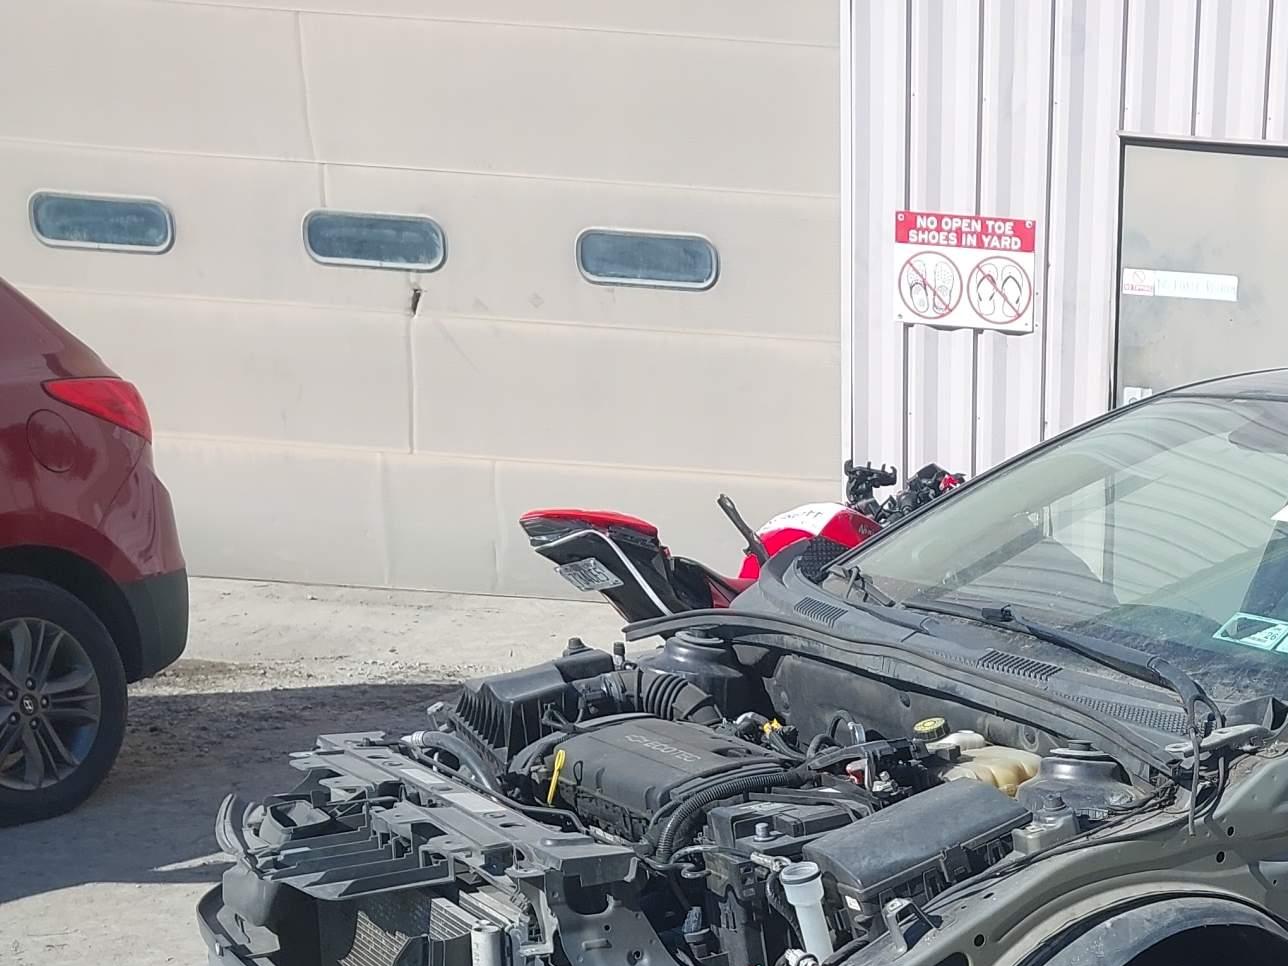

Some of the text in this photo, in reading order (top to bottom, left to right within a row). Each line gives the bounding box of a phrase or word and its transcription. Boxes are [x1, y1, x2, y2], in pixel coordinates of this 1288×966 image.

[916, 215, 1014, 235] NO OPEN TOE
[908, 229, 1022, 250] SHOES IN YARD
